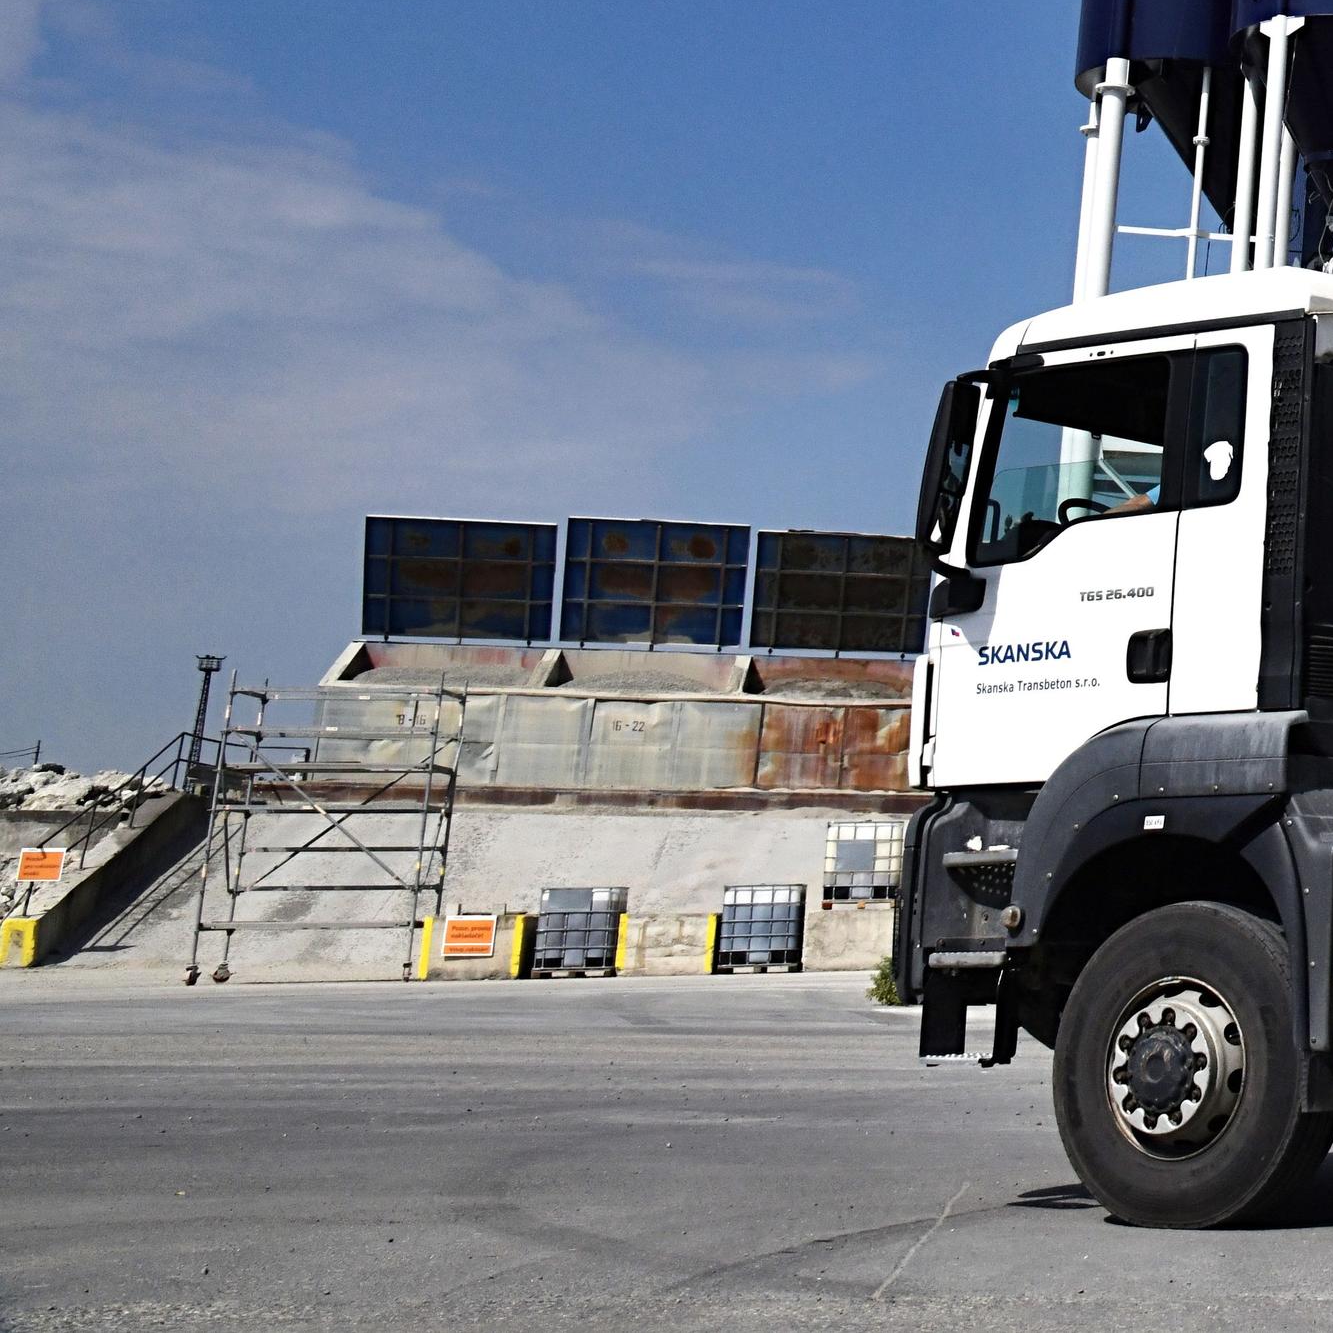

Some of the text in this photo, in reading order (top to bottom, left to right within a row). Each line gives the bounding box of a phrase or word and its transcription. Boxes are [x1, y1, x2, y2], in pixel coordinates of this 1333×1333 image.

[1079, 586, 1155, 603] TGS 26.400
[978, 639, 1072, 666] SKANSKA
[976, 677, 1101, 695] Skanska Transbeton s.r.o.
